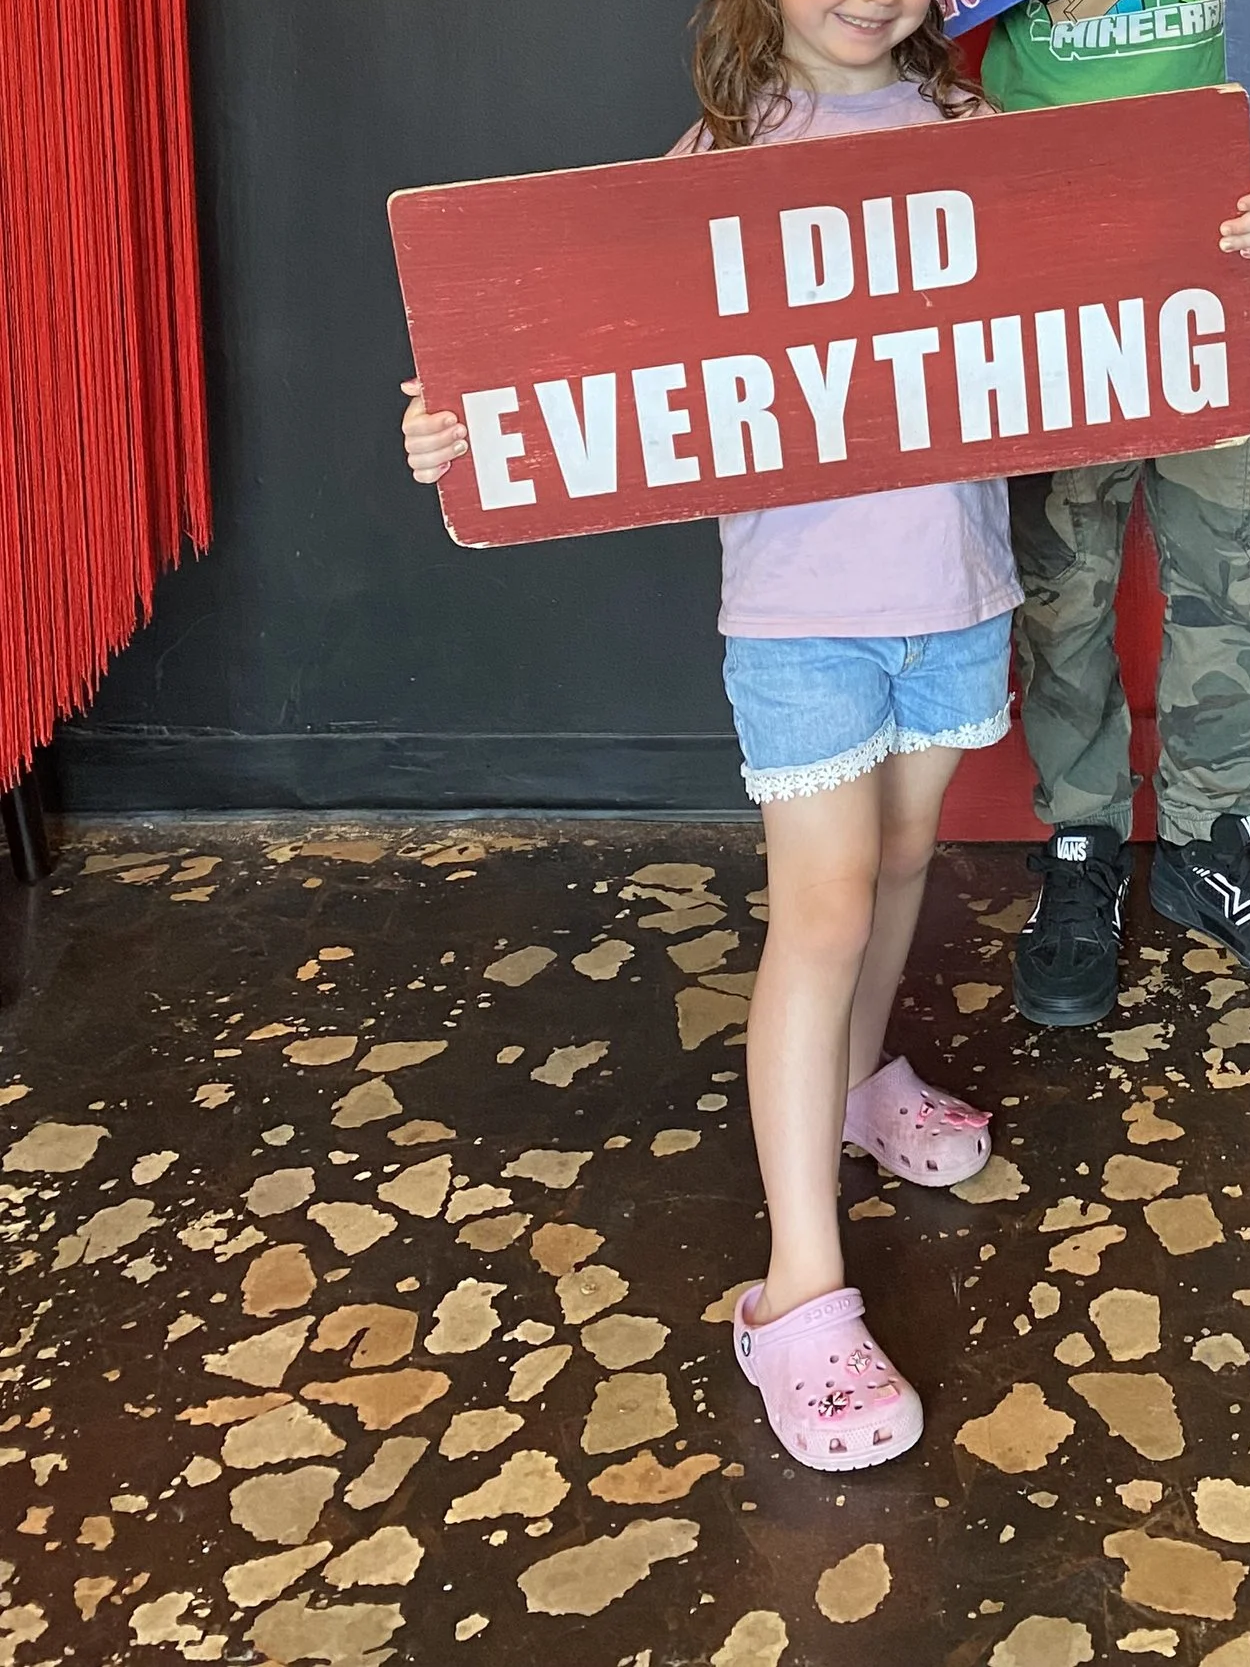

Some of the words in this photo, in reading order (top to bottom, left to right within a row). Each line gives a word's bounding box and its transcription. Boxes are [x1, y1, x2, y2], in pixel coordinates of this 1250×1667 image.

[709, 215, 751, 317] I
[779, 189, 978, 308] DID
[461, 288, 1230, 511] EVERYTHING
[1056, 836, 1087, 862] VANS
